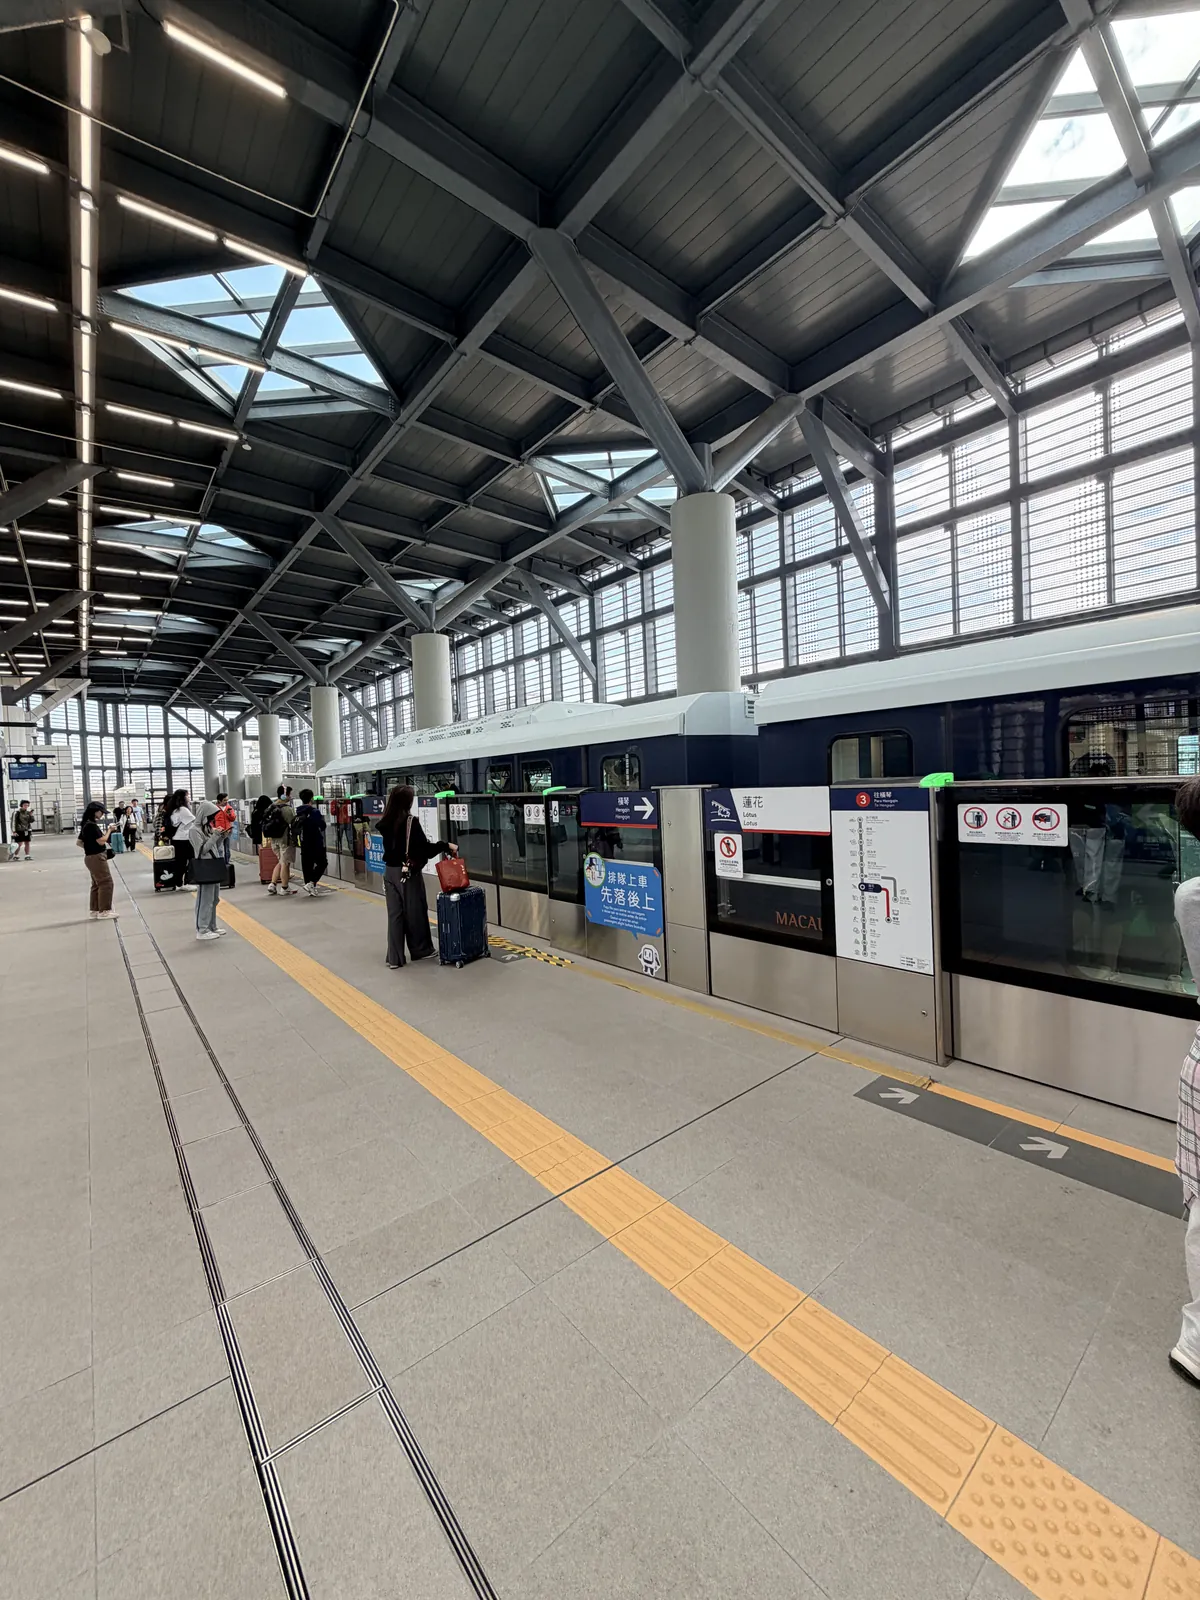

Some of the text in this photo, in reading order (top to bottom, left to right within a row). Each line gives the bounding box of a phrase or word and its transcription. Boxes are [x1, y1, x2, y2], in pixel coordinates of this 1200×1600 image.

[742, 796, 764, 809] 蓮花
[860, 794, 867, 805] 3
[553, 806, 558, 817] 6
[608, 871, 648, 888] 排隊上車
[601, 886, 655, 911] 先落後上
